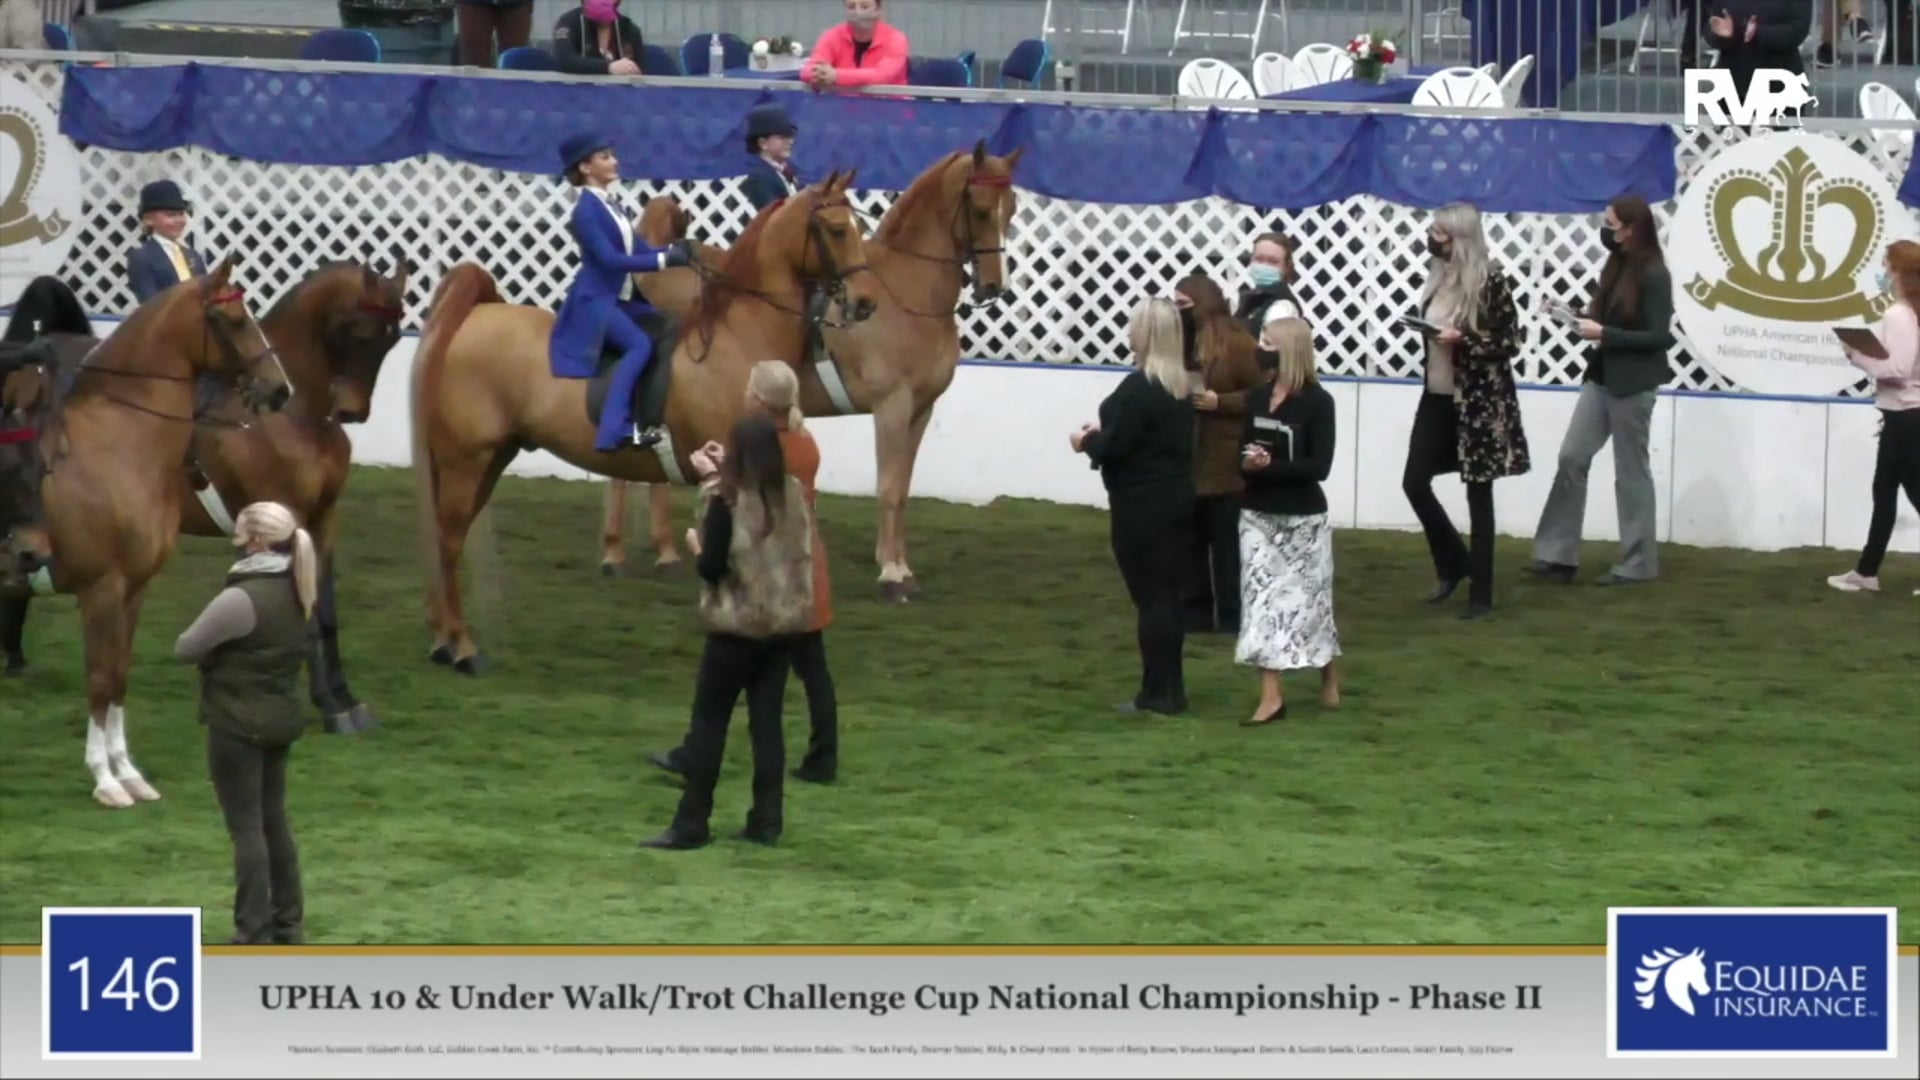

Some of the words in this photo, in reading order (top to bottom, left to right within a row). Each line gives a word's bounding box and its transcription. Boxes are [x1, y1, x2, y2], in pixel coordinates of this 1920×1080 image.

[1723, 324, 1758, 339] UPHA
[1761, 328, 1818, 345] American
[1717, 344, 1768, 360] National
